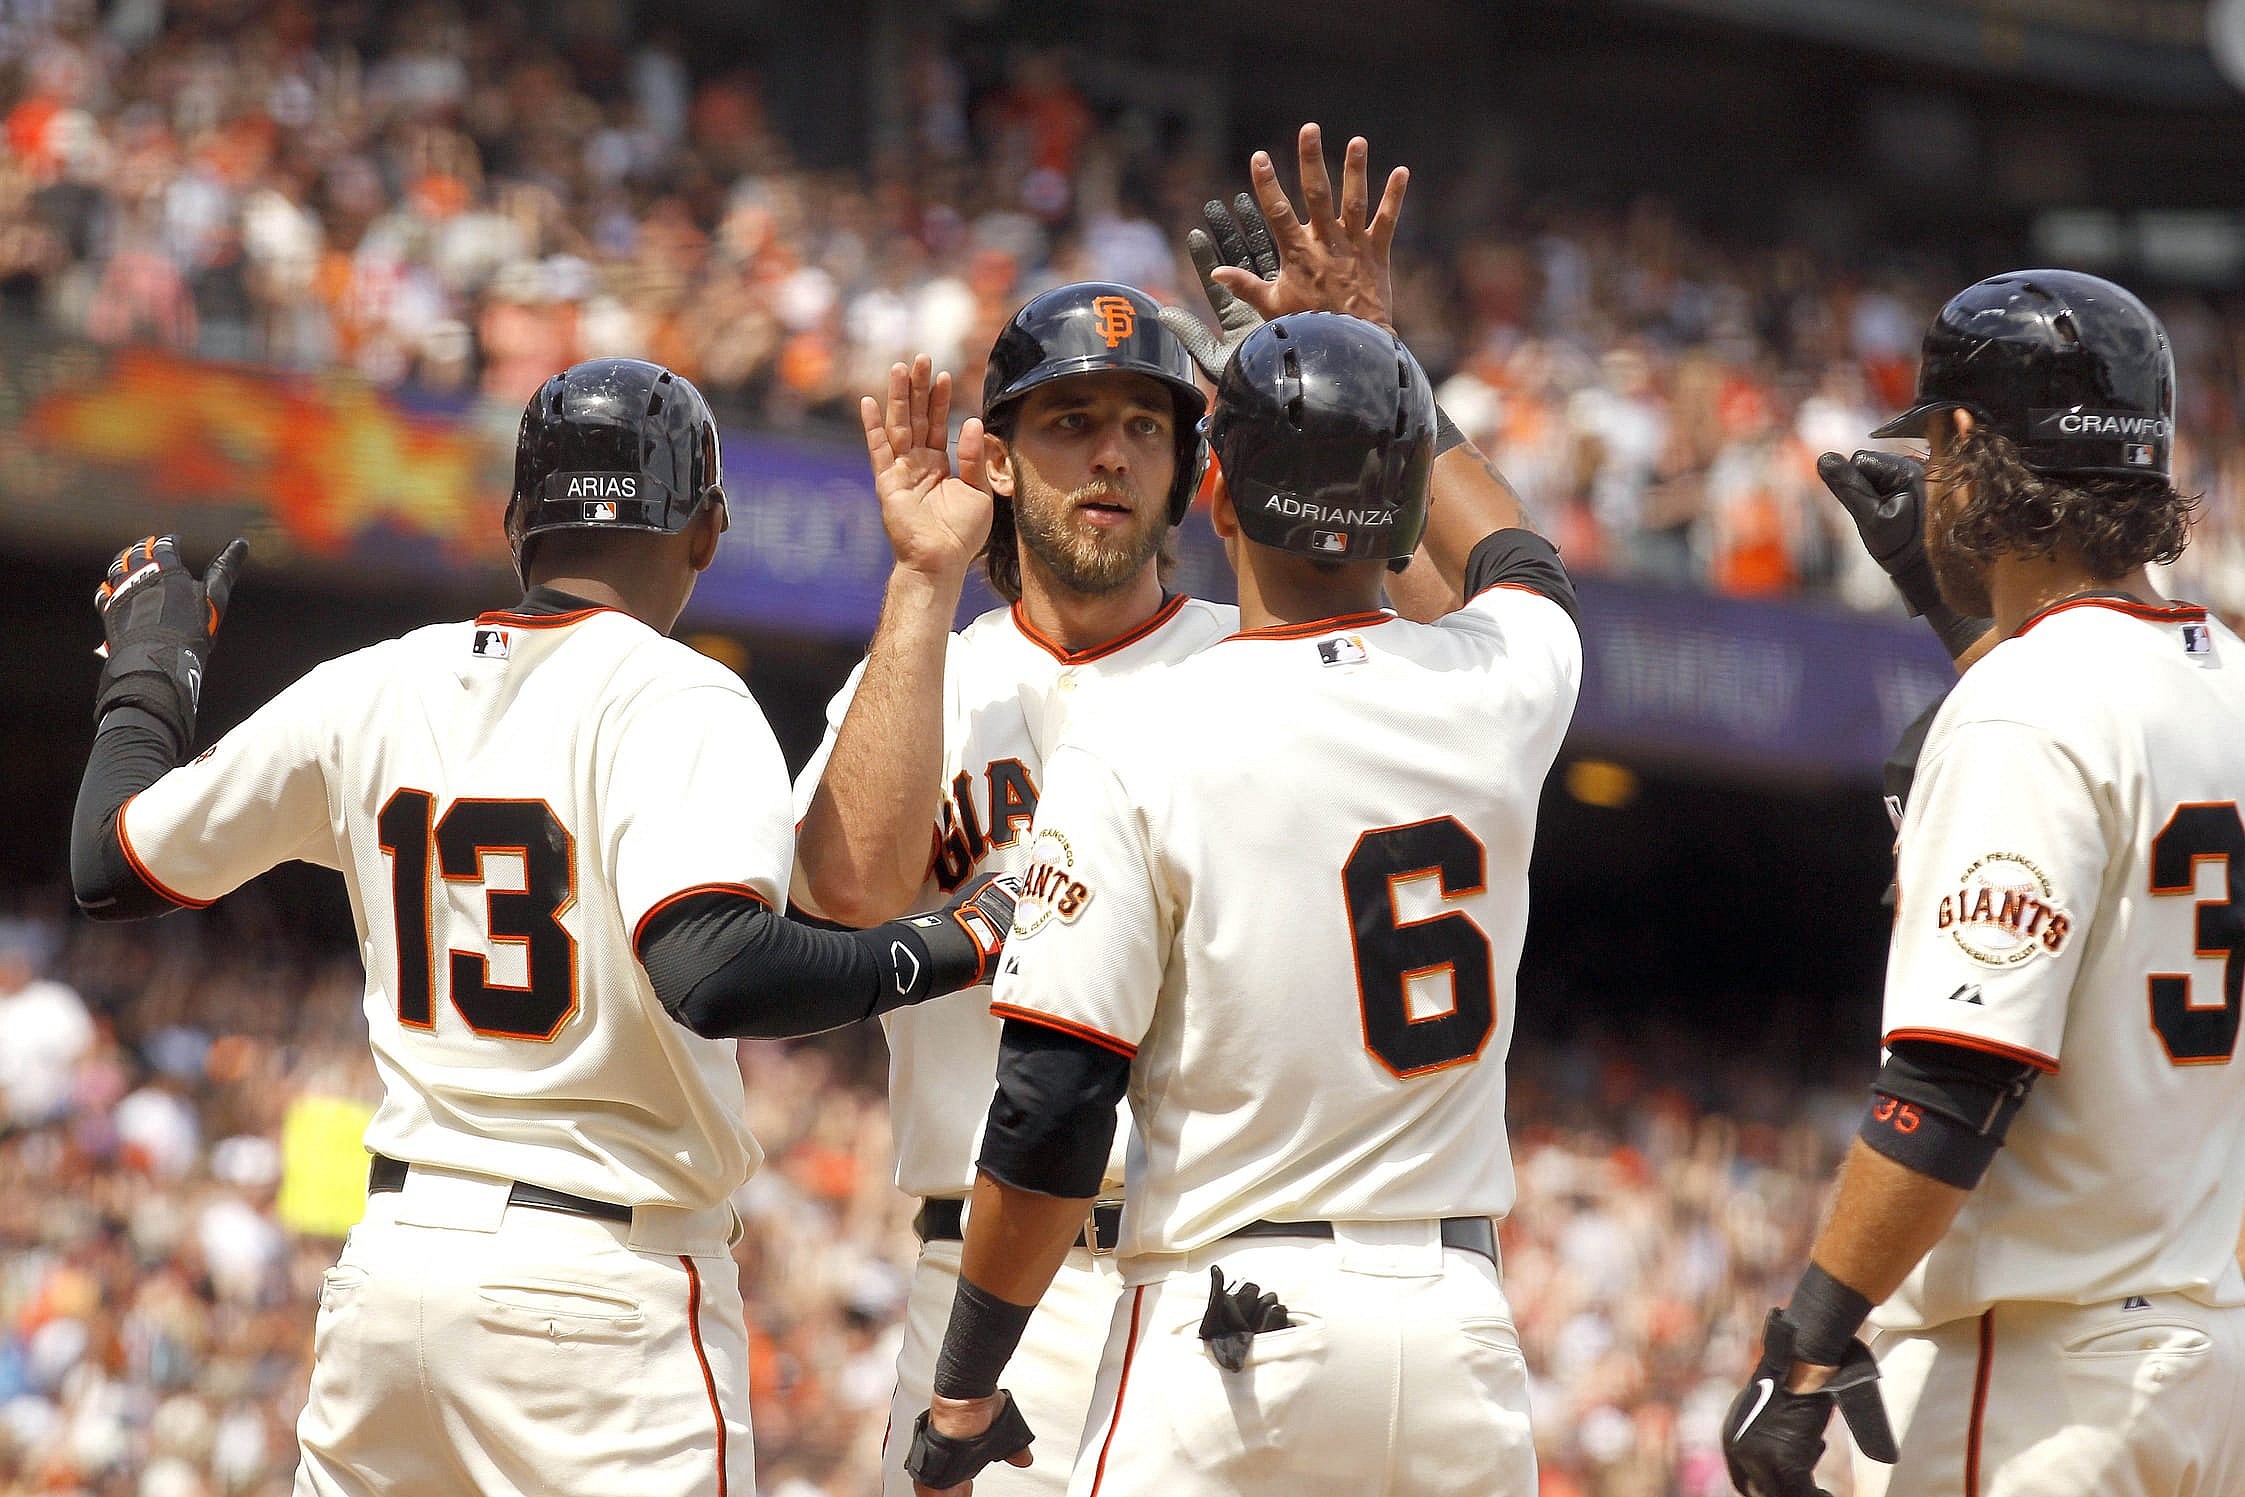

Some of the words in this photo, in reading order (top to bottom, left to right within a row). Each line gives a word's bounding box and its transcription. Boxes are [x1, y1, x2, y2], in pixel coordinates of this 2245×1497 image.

[567, 477, 636, 498] ARIAS
[1264, 494, 1393, 526] ADRIANZA
[377, 787, 580, 1044] 13
[1341, 815, 1498, 1081] 6
[1937, 887, 2070, 952] GIANTS
[2147, 800, 2245, 1066] 3
